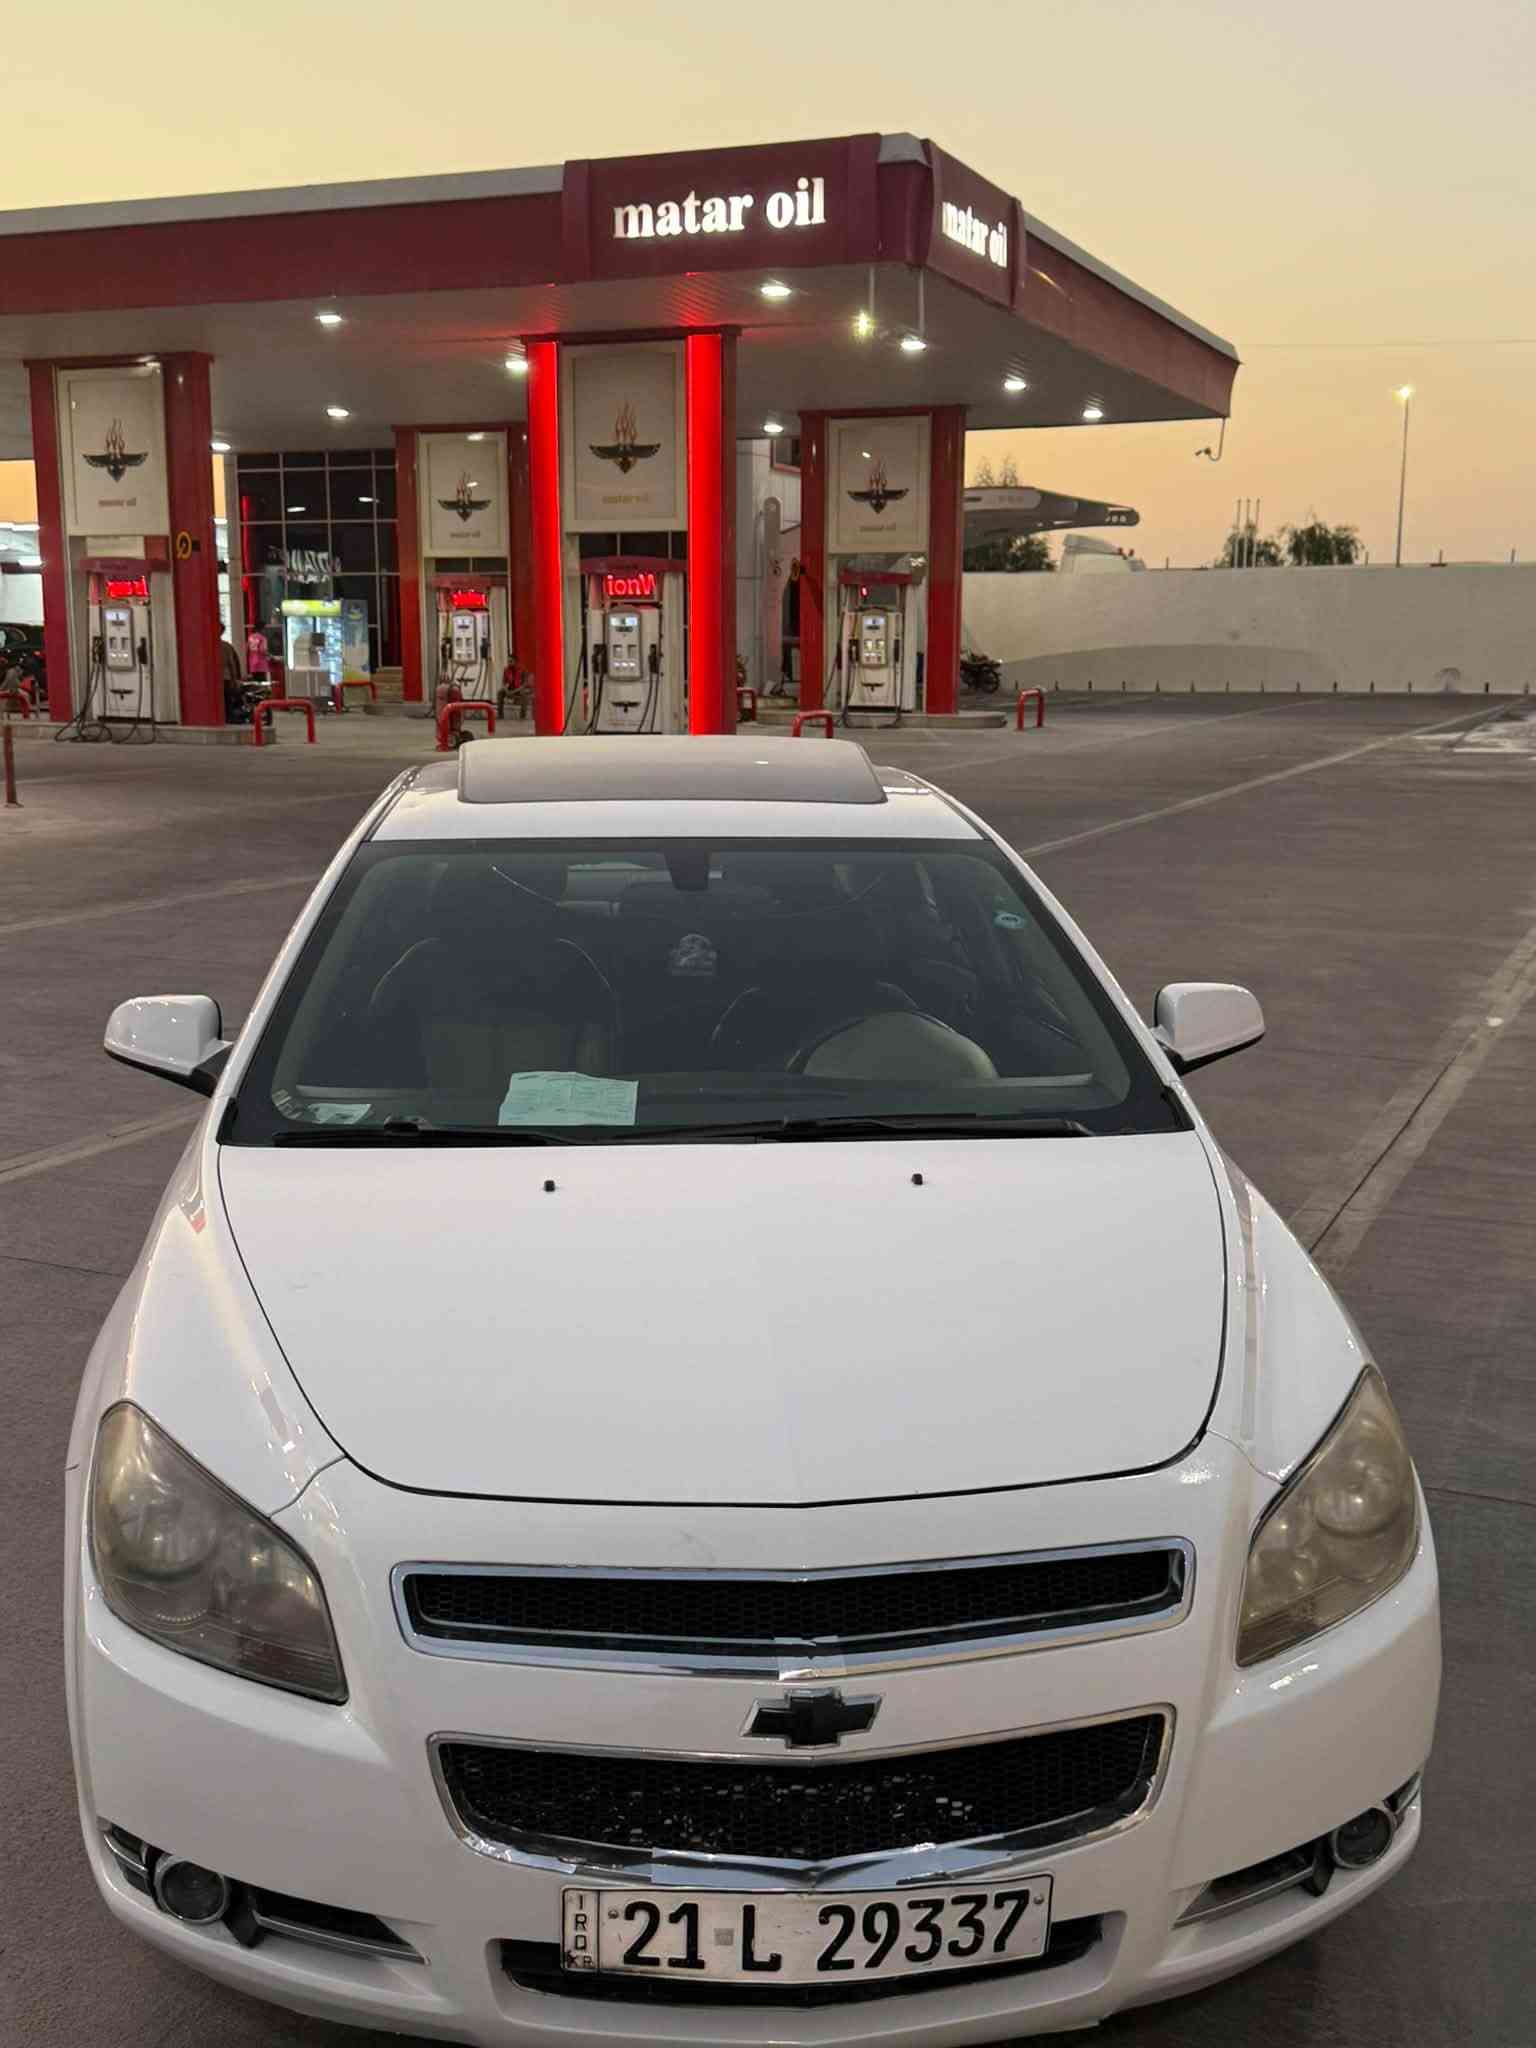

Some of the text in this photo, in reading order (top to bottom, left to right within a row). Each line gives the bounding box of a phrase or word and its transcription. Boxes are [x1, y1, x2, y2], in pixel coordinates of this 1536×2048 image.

[614, 177, 826, 238] matar oil
[942, 201, 1007, 268] matar oil
[623, 1889, 1030, 1971] 21 L 29337
